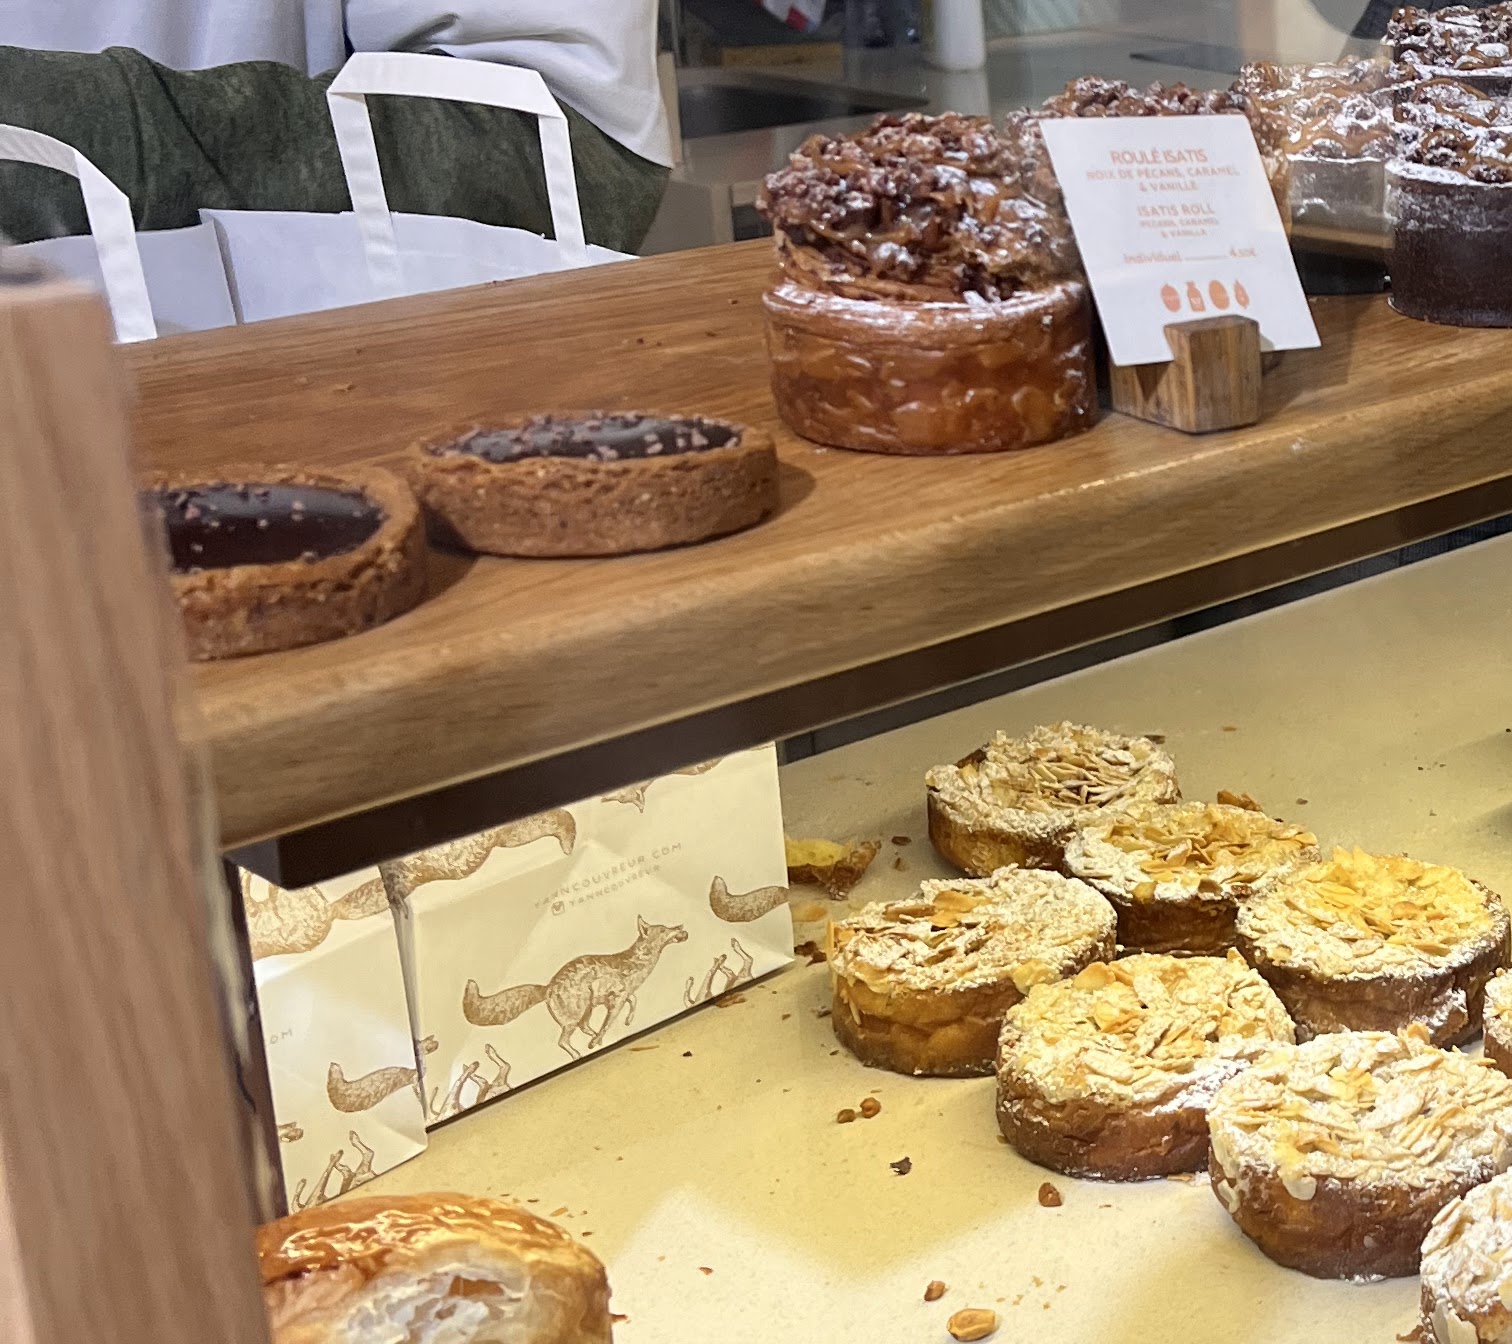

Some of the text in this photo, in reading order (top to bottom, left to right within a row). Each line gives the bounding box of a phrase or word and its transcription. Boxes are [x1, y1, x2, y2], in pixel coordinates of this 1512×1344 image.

[1110, 147, 1208, 165] ROULÉ ISATIS
[1149, 180, 1198, 192] VANILLE
[1137, 203, 1215, 217] ISATIS ROLL
